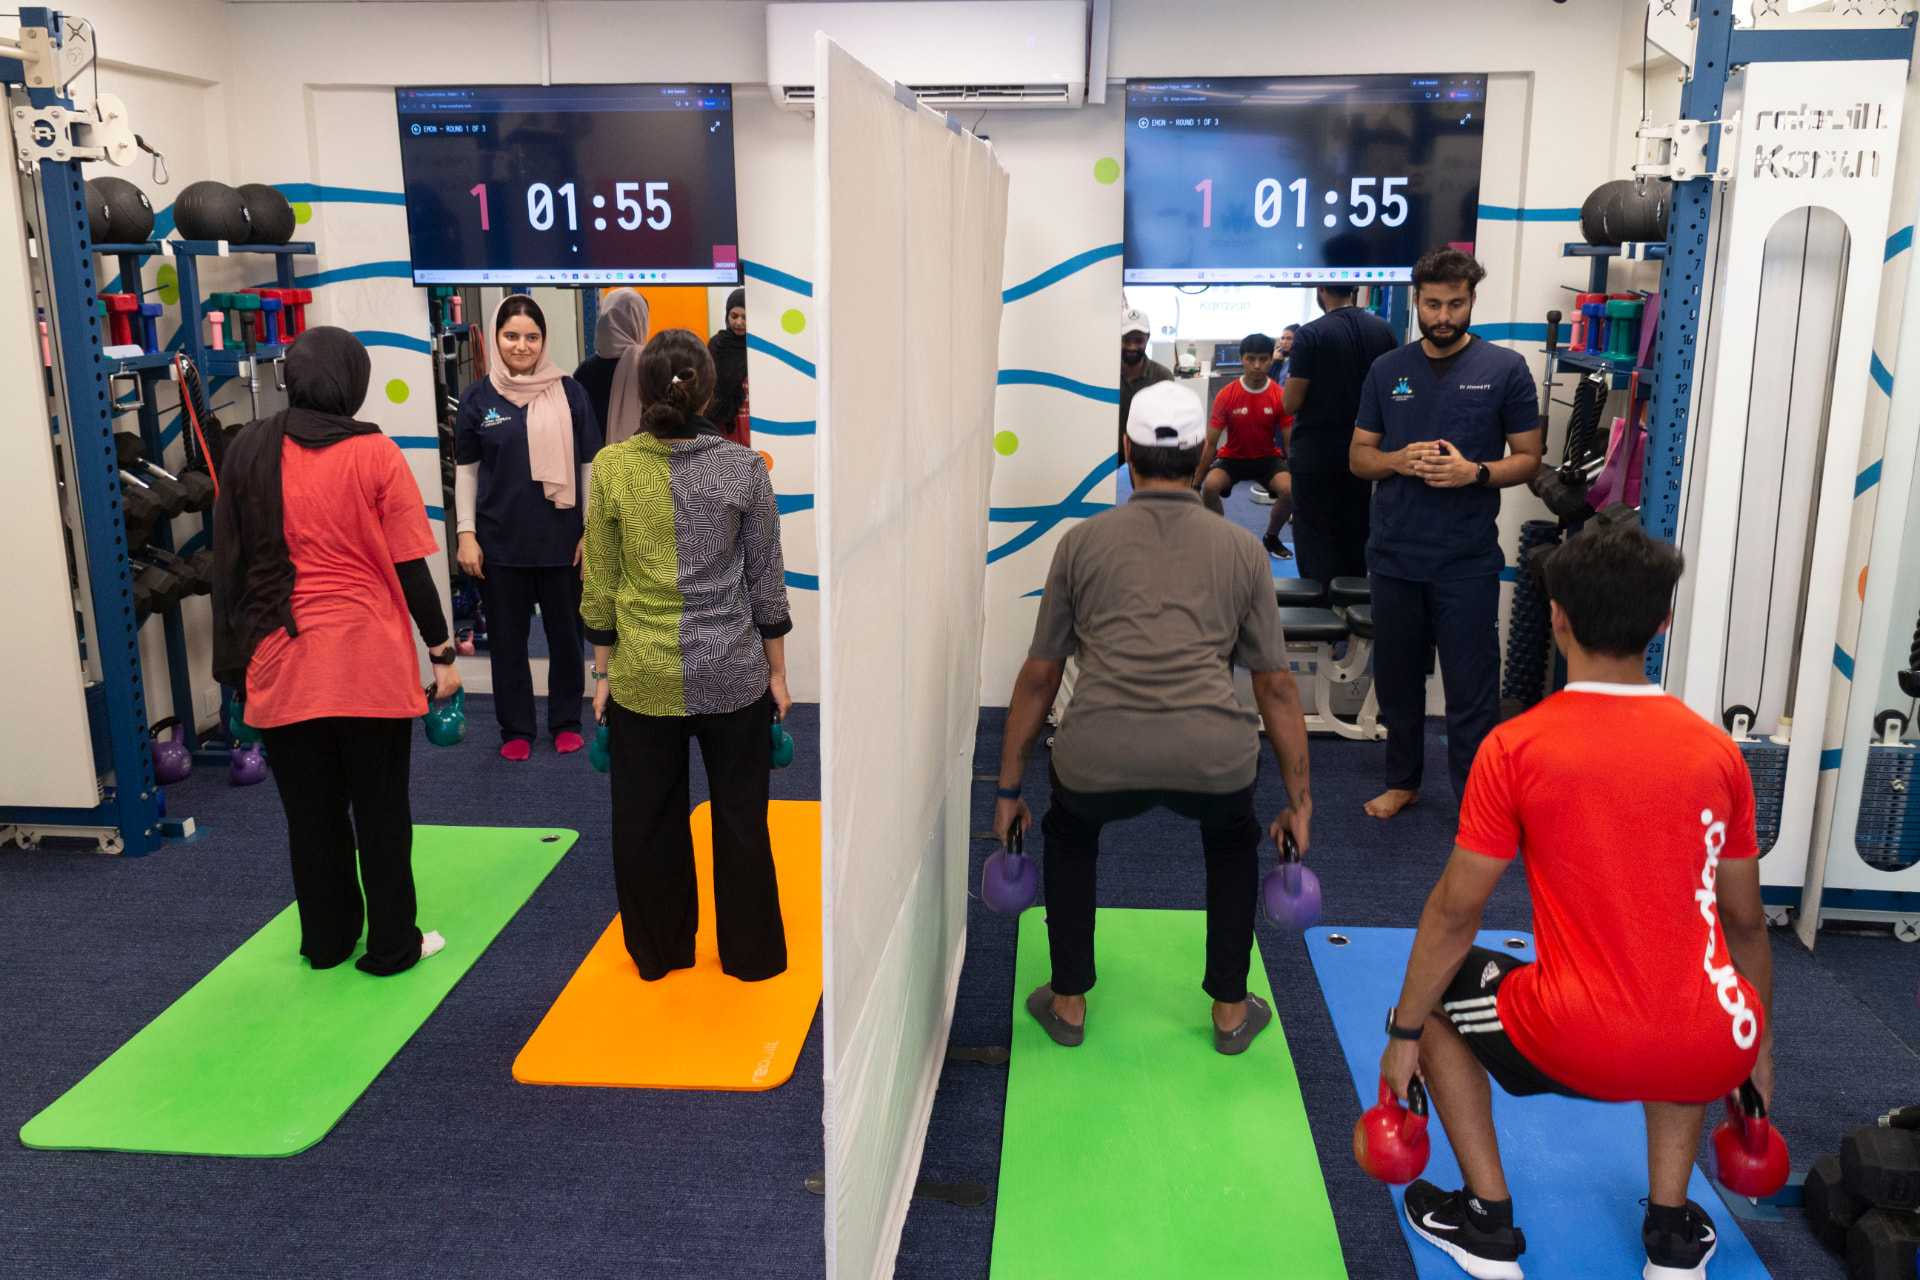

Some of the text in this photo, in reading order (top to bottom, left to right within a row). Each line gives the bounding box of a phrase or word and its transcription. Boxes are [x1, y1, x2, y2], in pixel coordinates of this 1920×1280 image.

[1175, 118, 1194, 126] ROUND
[1203, 118, 1212, 126] OF
[445, 125, 463, 133] ROUND
[471, 125, 479, 133] OF
[470, 182, 672, 231] 1 01:55
[1195, 177, 1408, 228] 1 01:55
[1700, 208, 1706, 219] 5
[1697, 234, 1704, 245] 6
[1695, 259, 1701, 270] 7
[1199, 299, 1251, 311] Karavan
[1689, 309, 1696, 320] 9
[1683, 334, 1693, 345] 10
[1682, 359, 1691, 370] 11
[1677, 383, 1688, 395] 12
[1675, 407, 1685, 419] 13
[1671, 455, 1682, 467] 15
[1668, 480, 1678, 491] 16
[1665, 503, 1676, 515] 17
[1663, 527, 1673, 538] 18
[1648, 642, 1661, 653] 23
[1646, 665, 1659, 676] 24
